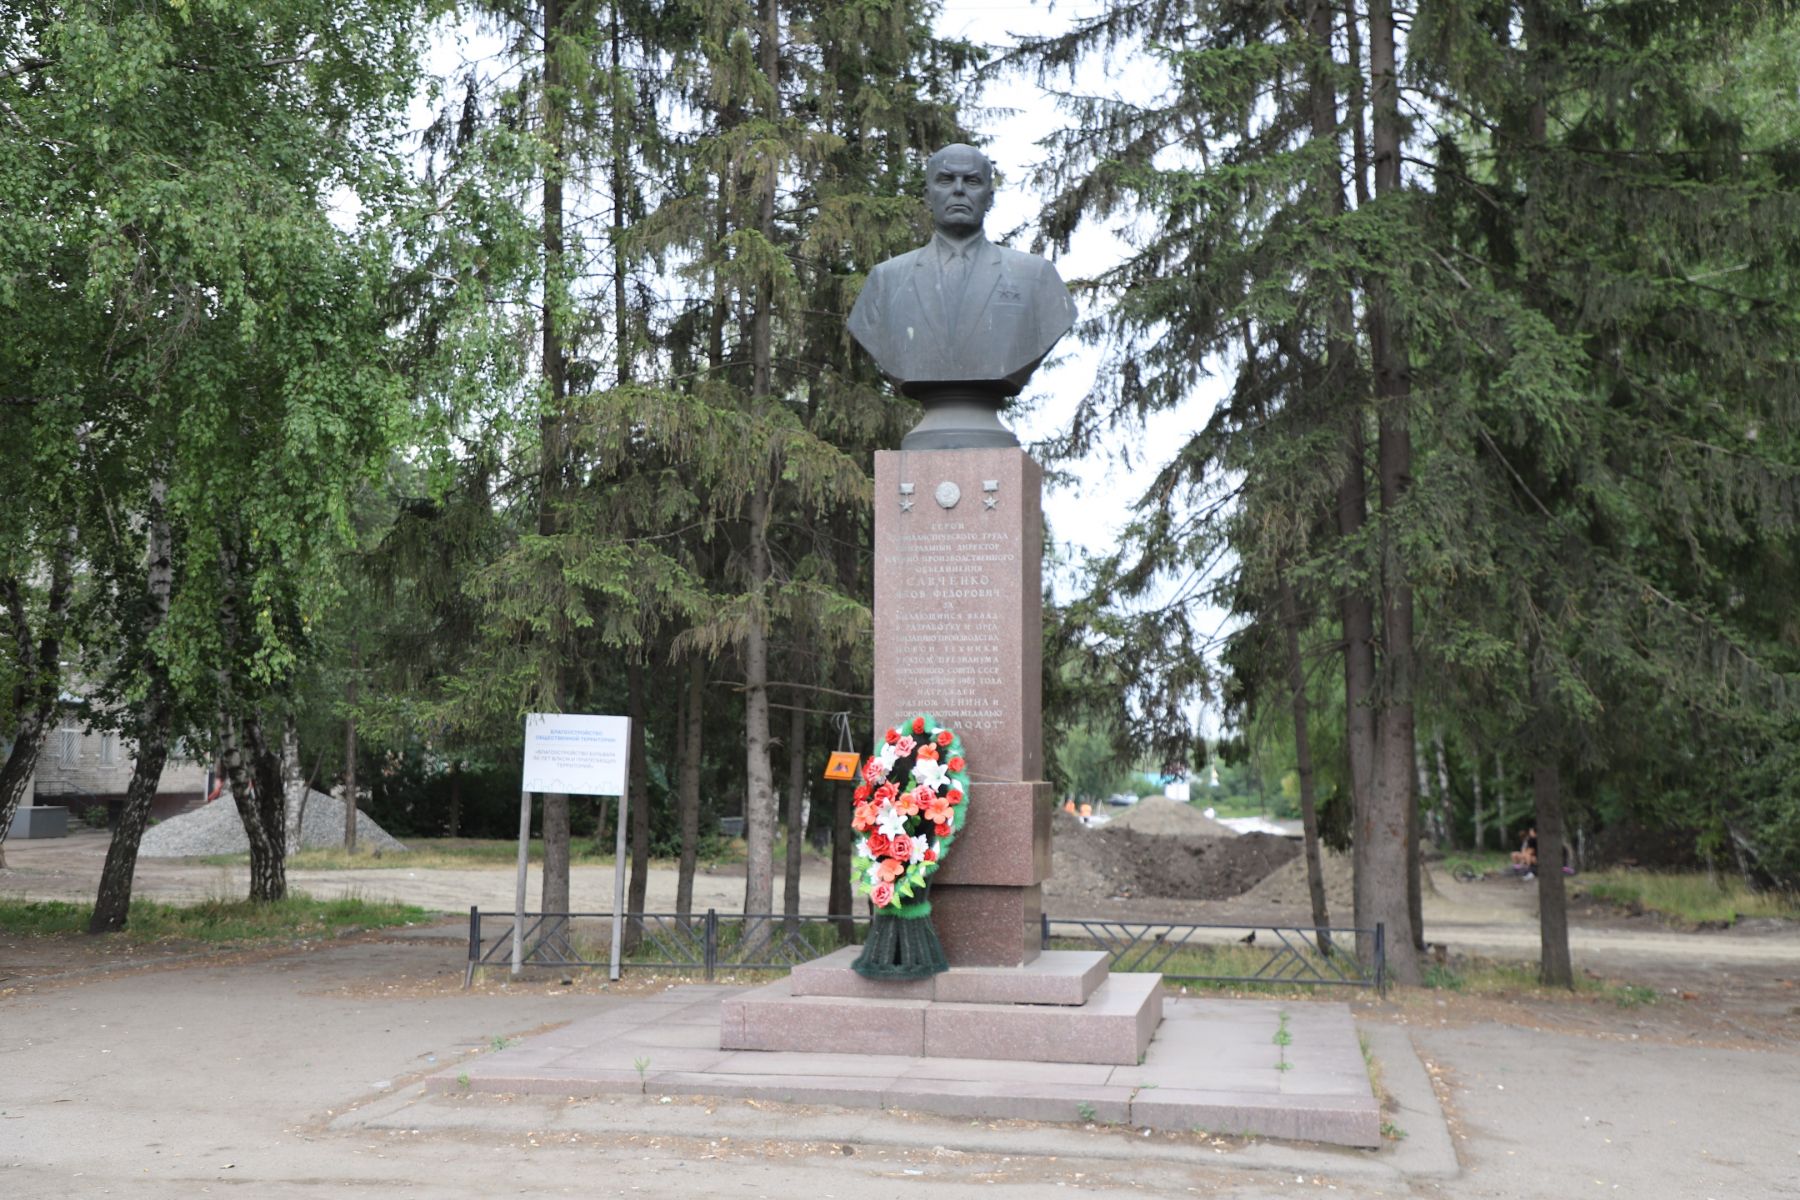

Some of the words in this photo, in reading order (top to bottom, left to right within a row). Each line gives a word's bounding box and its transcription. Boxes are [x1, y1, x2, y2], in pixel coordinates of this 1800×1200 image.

[896, 533, 978, 542] ИАЛИСТИЧЕСКОГО
[982, 532, 1009, 540] ТРУДА
[896, 543, 952, 552] ГЕРАЛЬНЫЙ
[957, 543, 1000, 551] ДИРЕКТОР
[906, 574, 990, 586] САВЧЕНКО
[967, 612, 999, 620] ВКЛАД
[896, 634, 937, 642] ЗАЦИЮ
[980, 677, 1002, 685] ГОДА
[944, 698, 988, 706] ЛЕНИНА
